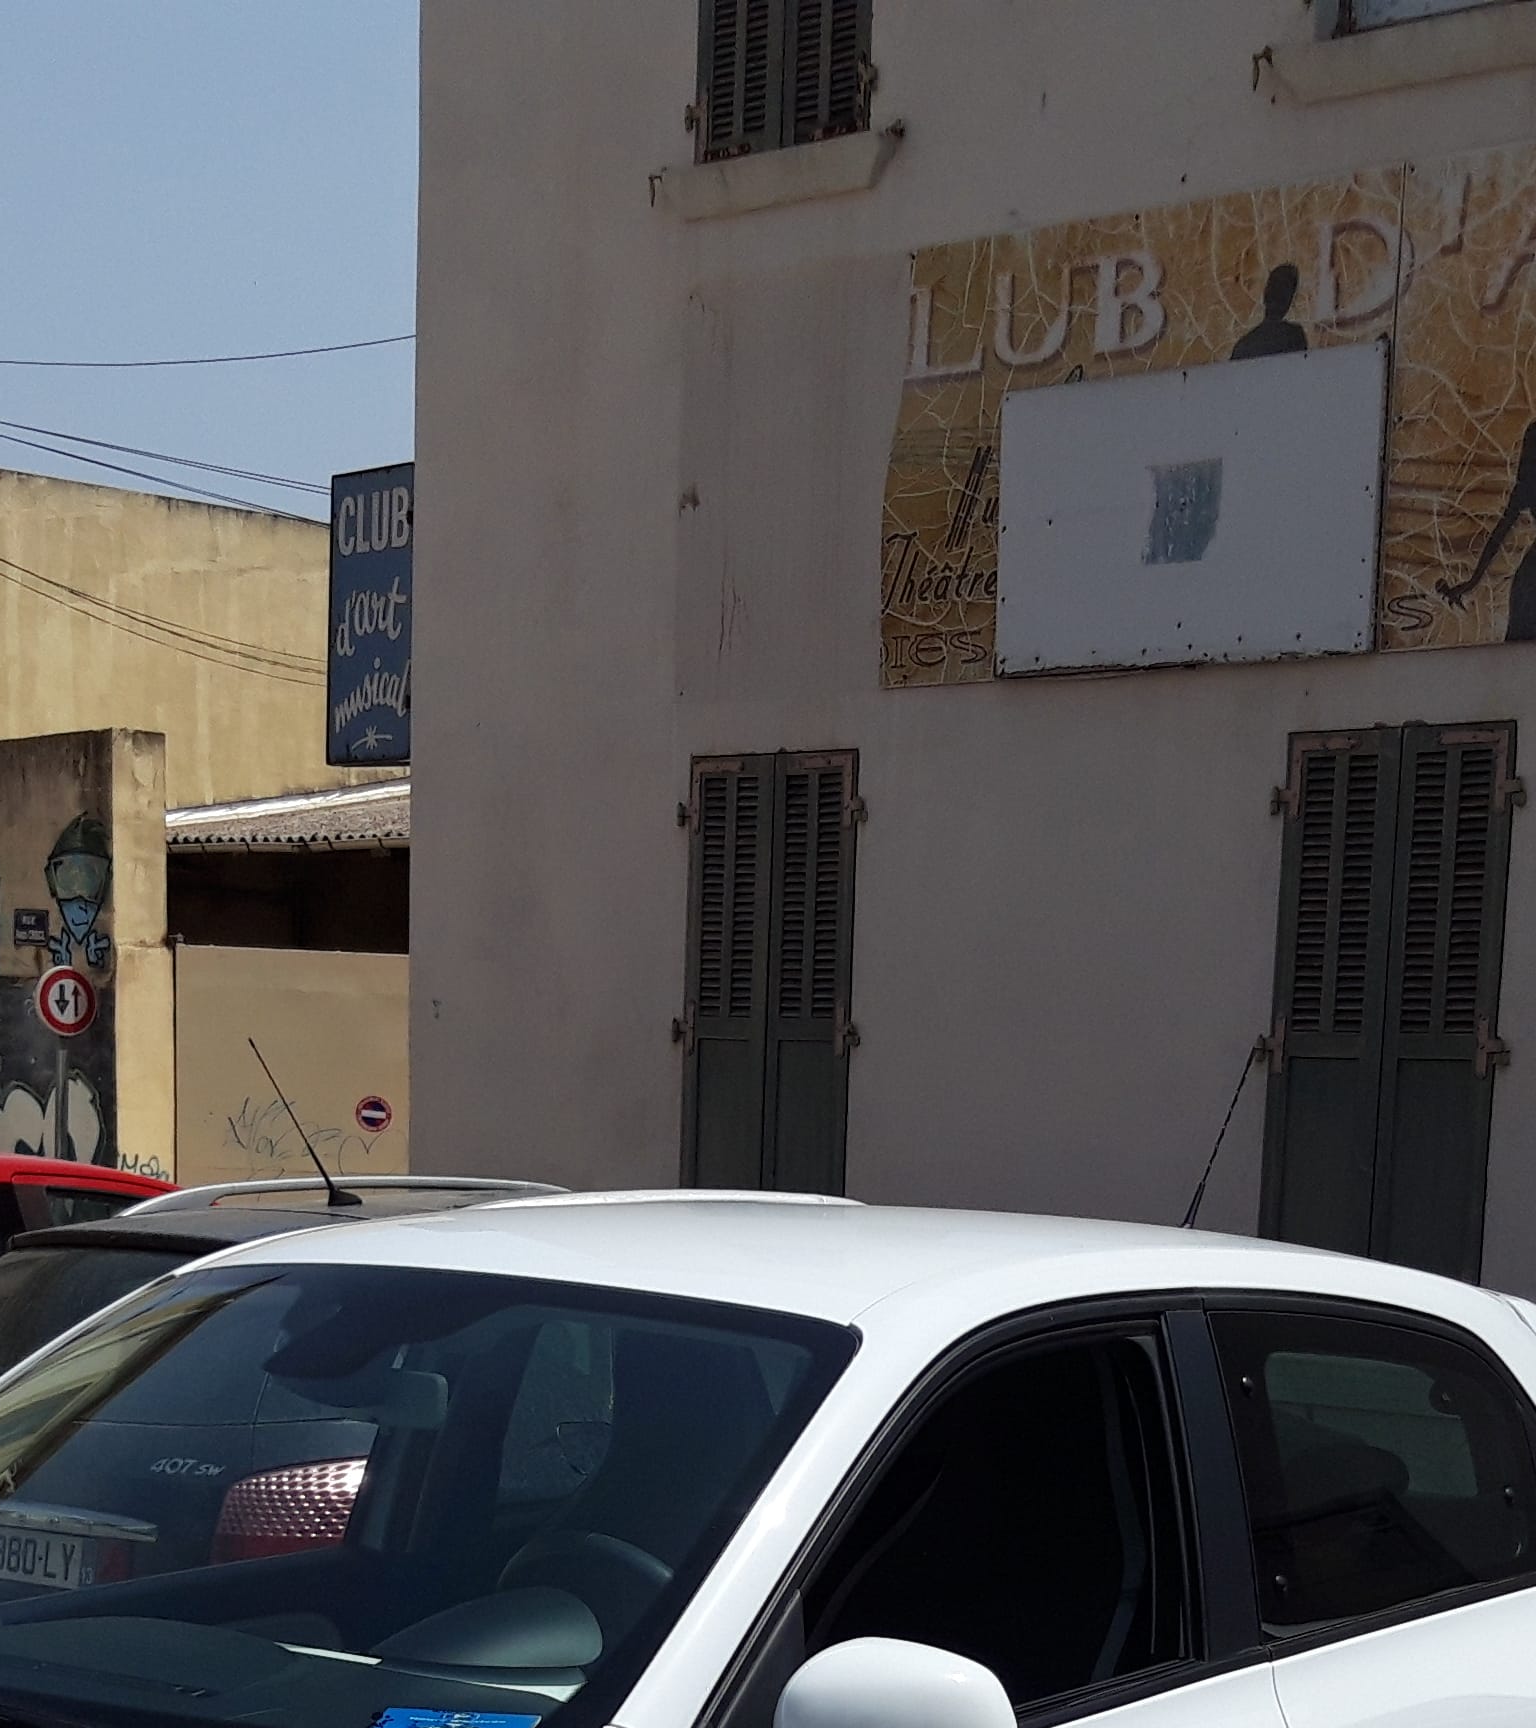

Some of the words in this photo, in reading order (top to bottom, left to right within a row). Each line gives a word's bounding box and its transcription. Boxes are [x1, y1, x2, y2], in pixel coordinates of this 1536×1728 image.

[337, 486, 410, 556] CLUB
[336, 576, 406, 656] d'art
[335, 656, 412, 733] musical
[150, 1458, 198, 1474] 407
